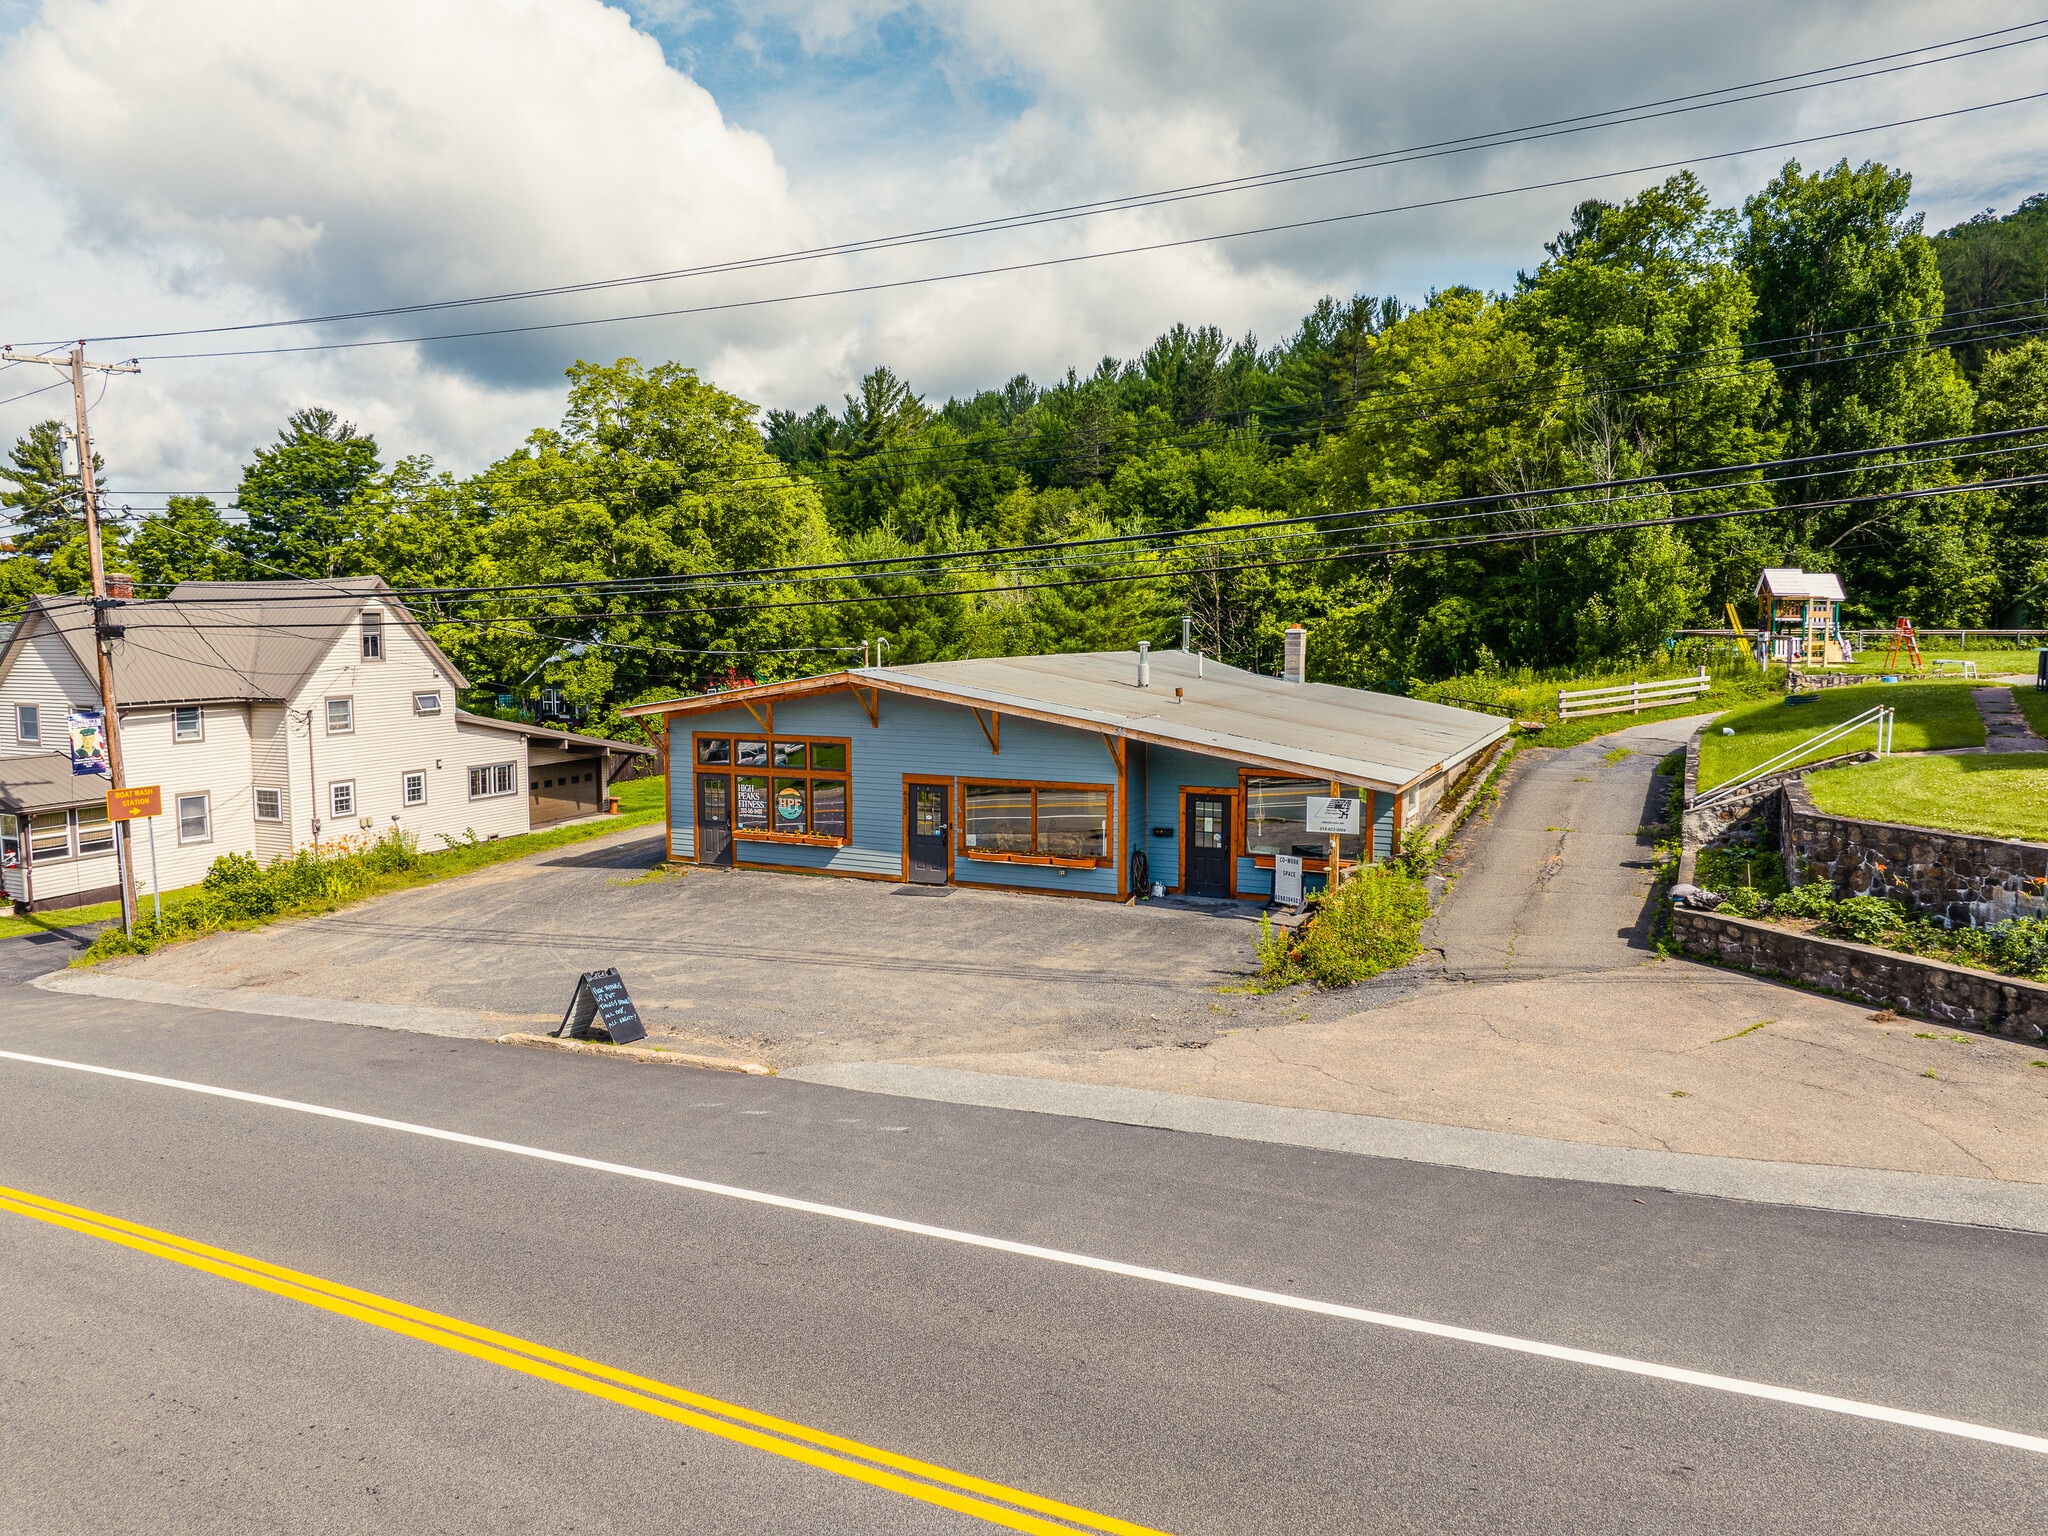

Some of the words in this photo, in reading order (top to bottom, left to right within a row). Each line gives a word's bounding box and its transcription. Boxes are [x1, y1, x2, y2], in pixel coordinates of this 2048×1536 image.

[738, 784, 754, 792] HIGH
[115, 791, 133, 799] BOAT
[122, 798, 150, 806] STATION
[738, 800, 764, 808] FITNESS
[779, 798, 801, 810] HPF
[1280, 857, 1299, 865] CO-WORK
[608, 1020, 618, 1028] ALL
